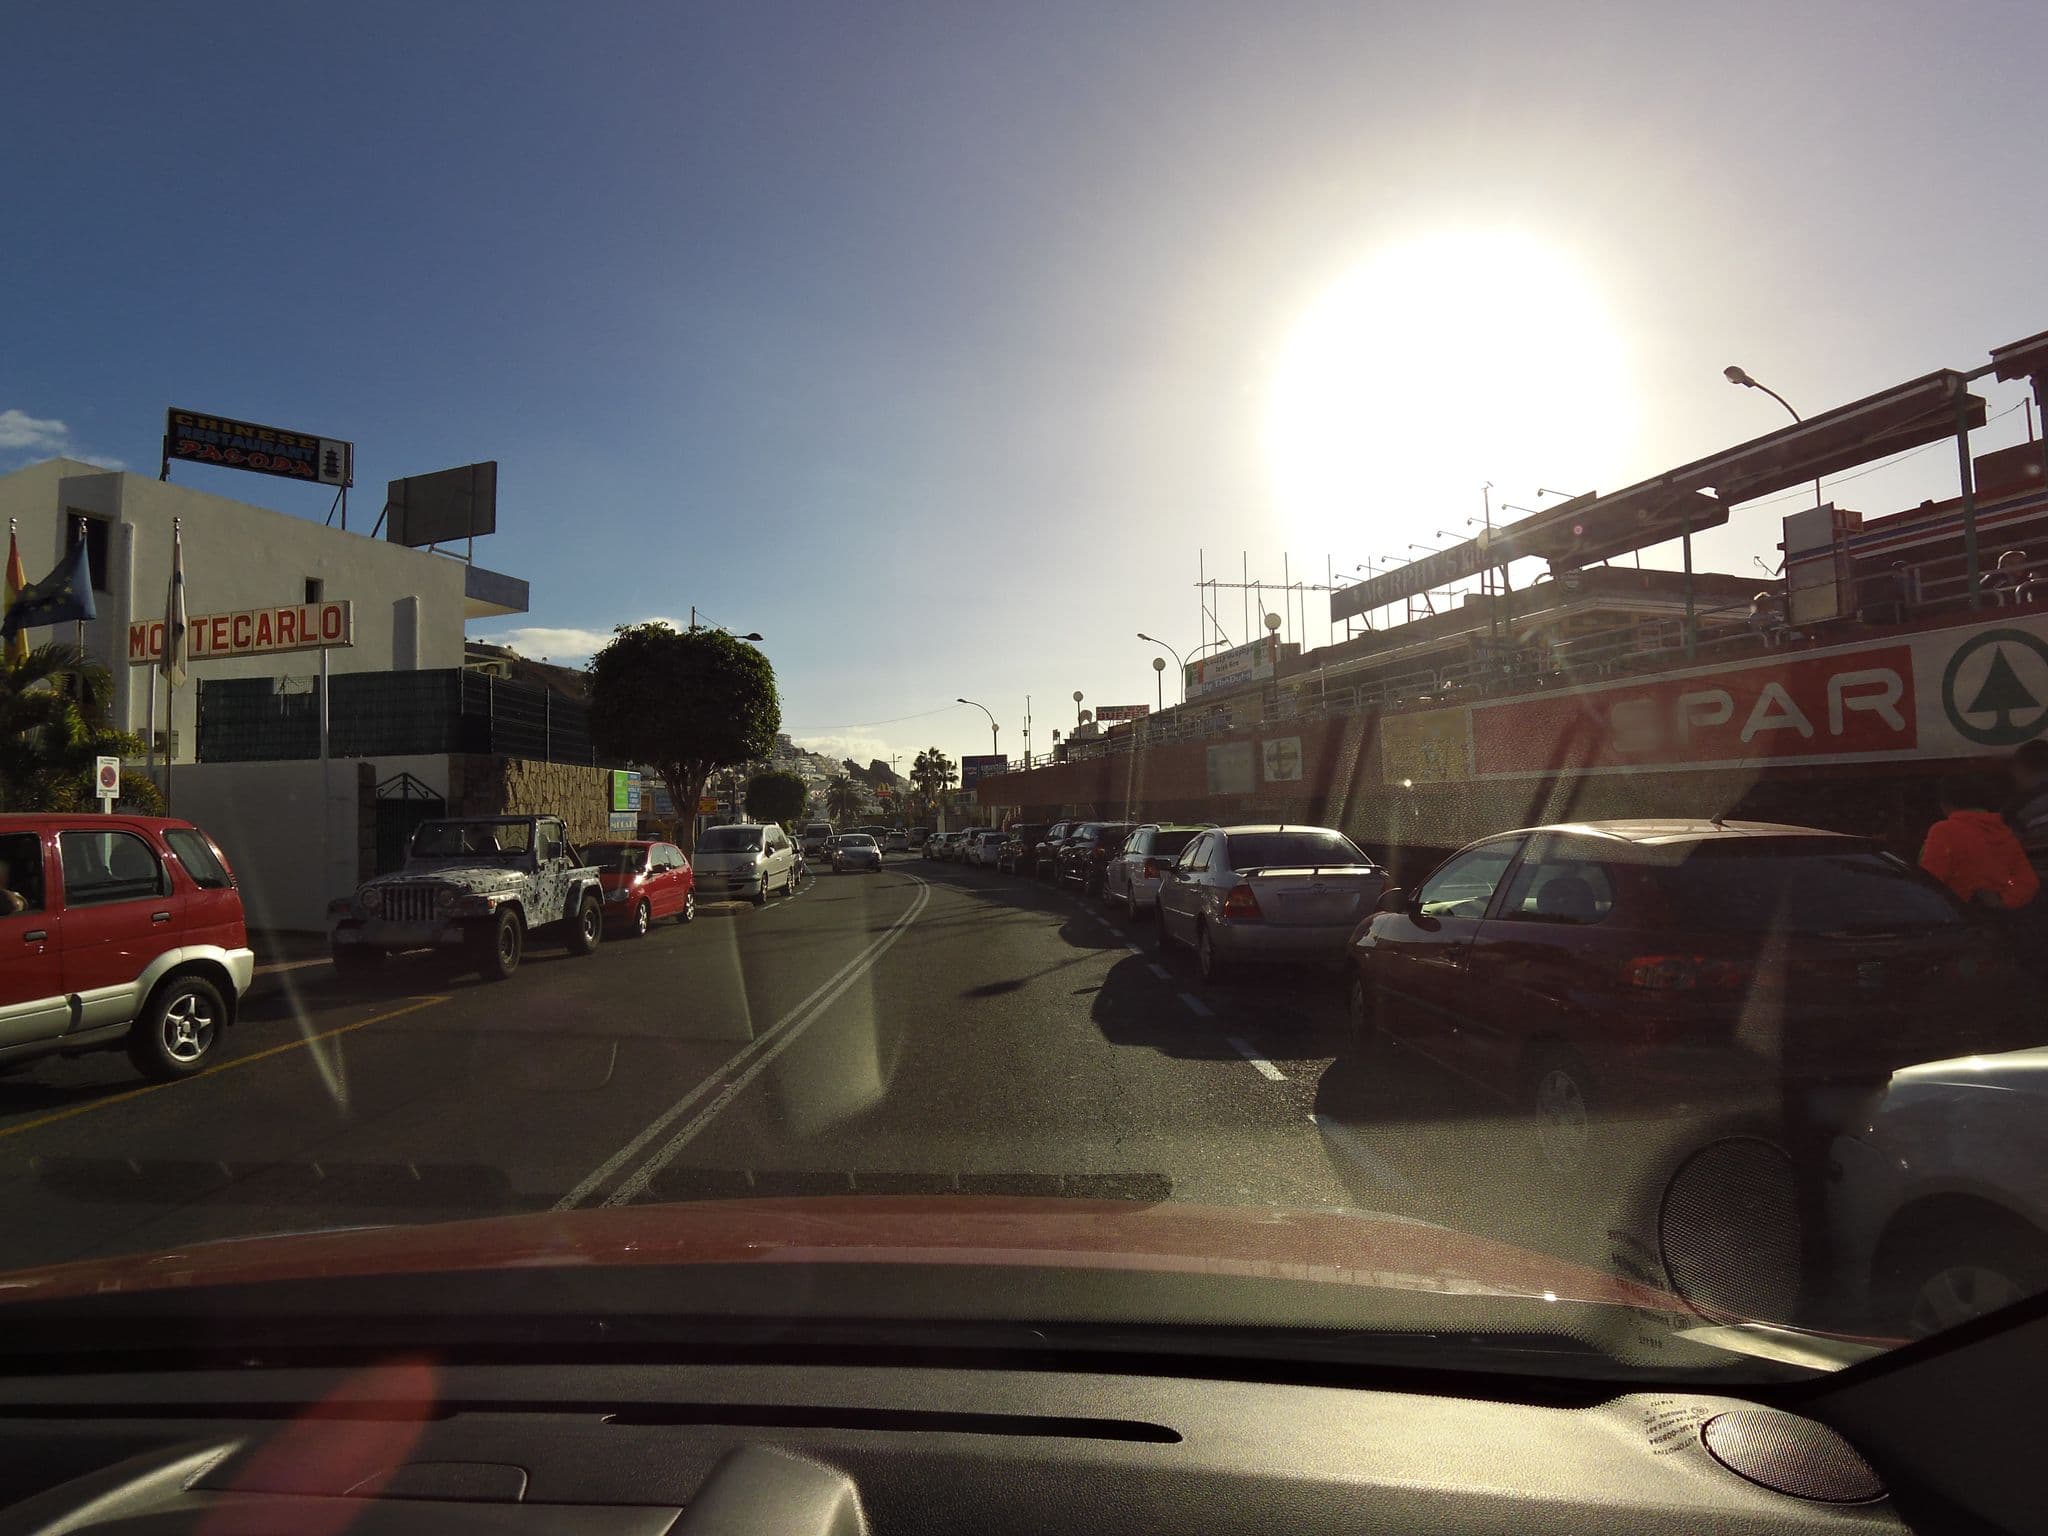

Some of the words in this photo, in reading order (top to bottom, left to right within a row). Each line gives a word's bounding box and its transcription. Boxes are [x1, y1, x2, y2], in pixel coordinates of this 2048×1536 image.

[175, 413, 317, 449] CHINESE
[177, 425, 316, 462] RESTAURANT
[175, 439, 315, 478] PAGODA
[128, 605, 342, 658] MOTECARLO
[1610, 667, 1906, 752] PAR
